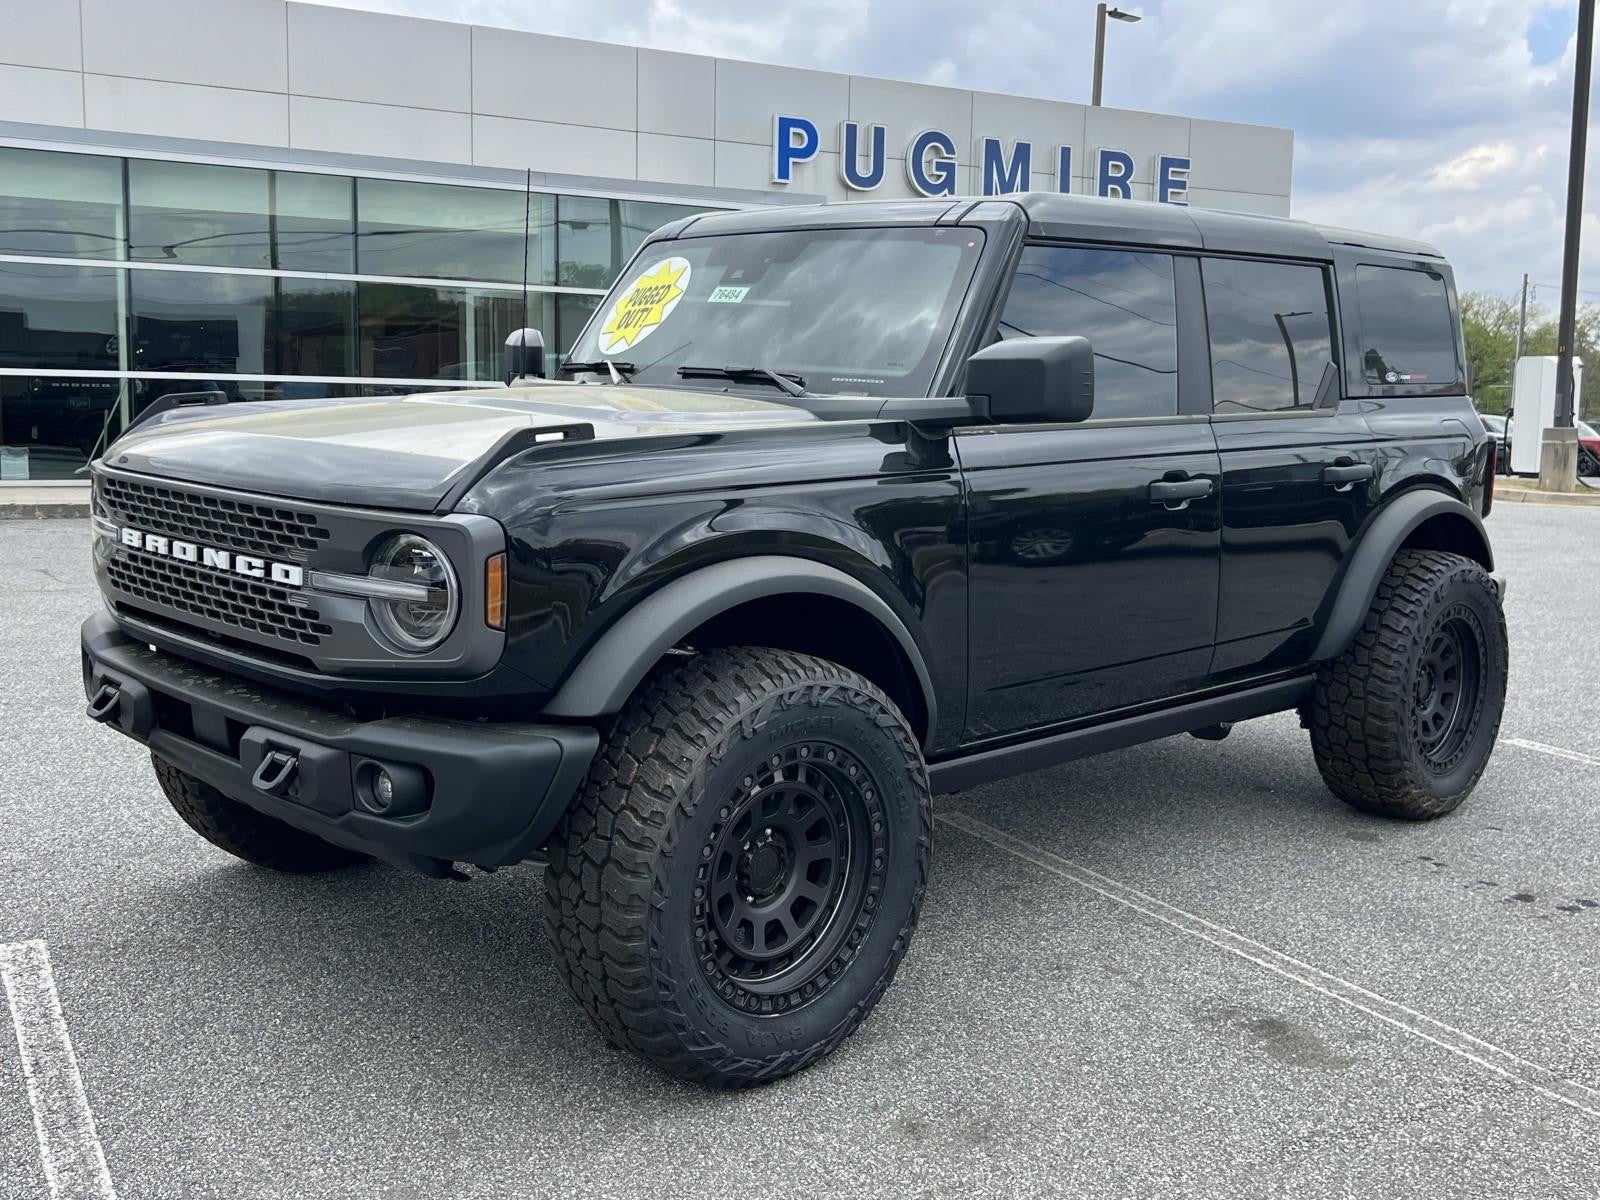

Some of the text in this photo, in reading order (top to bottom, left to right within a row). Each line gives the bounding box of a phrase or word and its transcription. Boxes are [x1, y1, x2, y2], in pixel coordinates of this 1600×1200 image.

[772, 113, 1192, 206] PUGMIRE
[624, 284, 672, 308] PUGGED
[713, 288, 742, 300] 76484
[615, 306, 653, 330] OUT!
[121, 527, 304, 586] BRONCO
